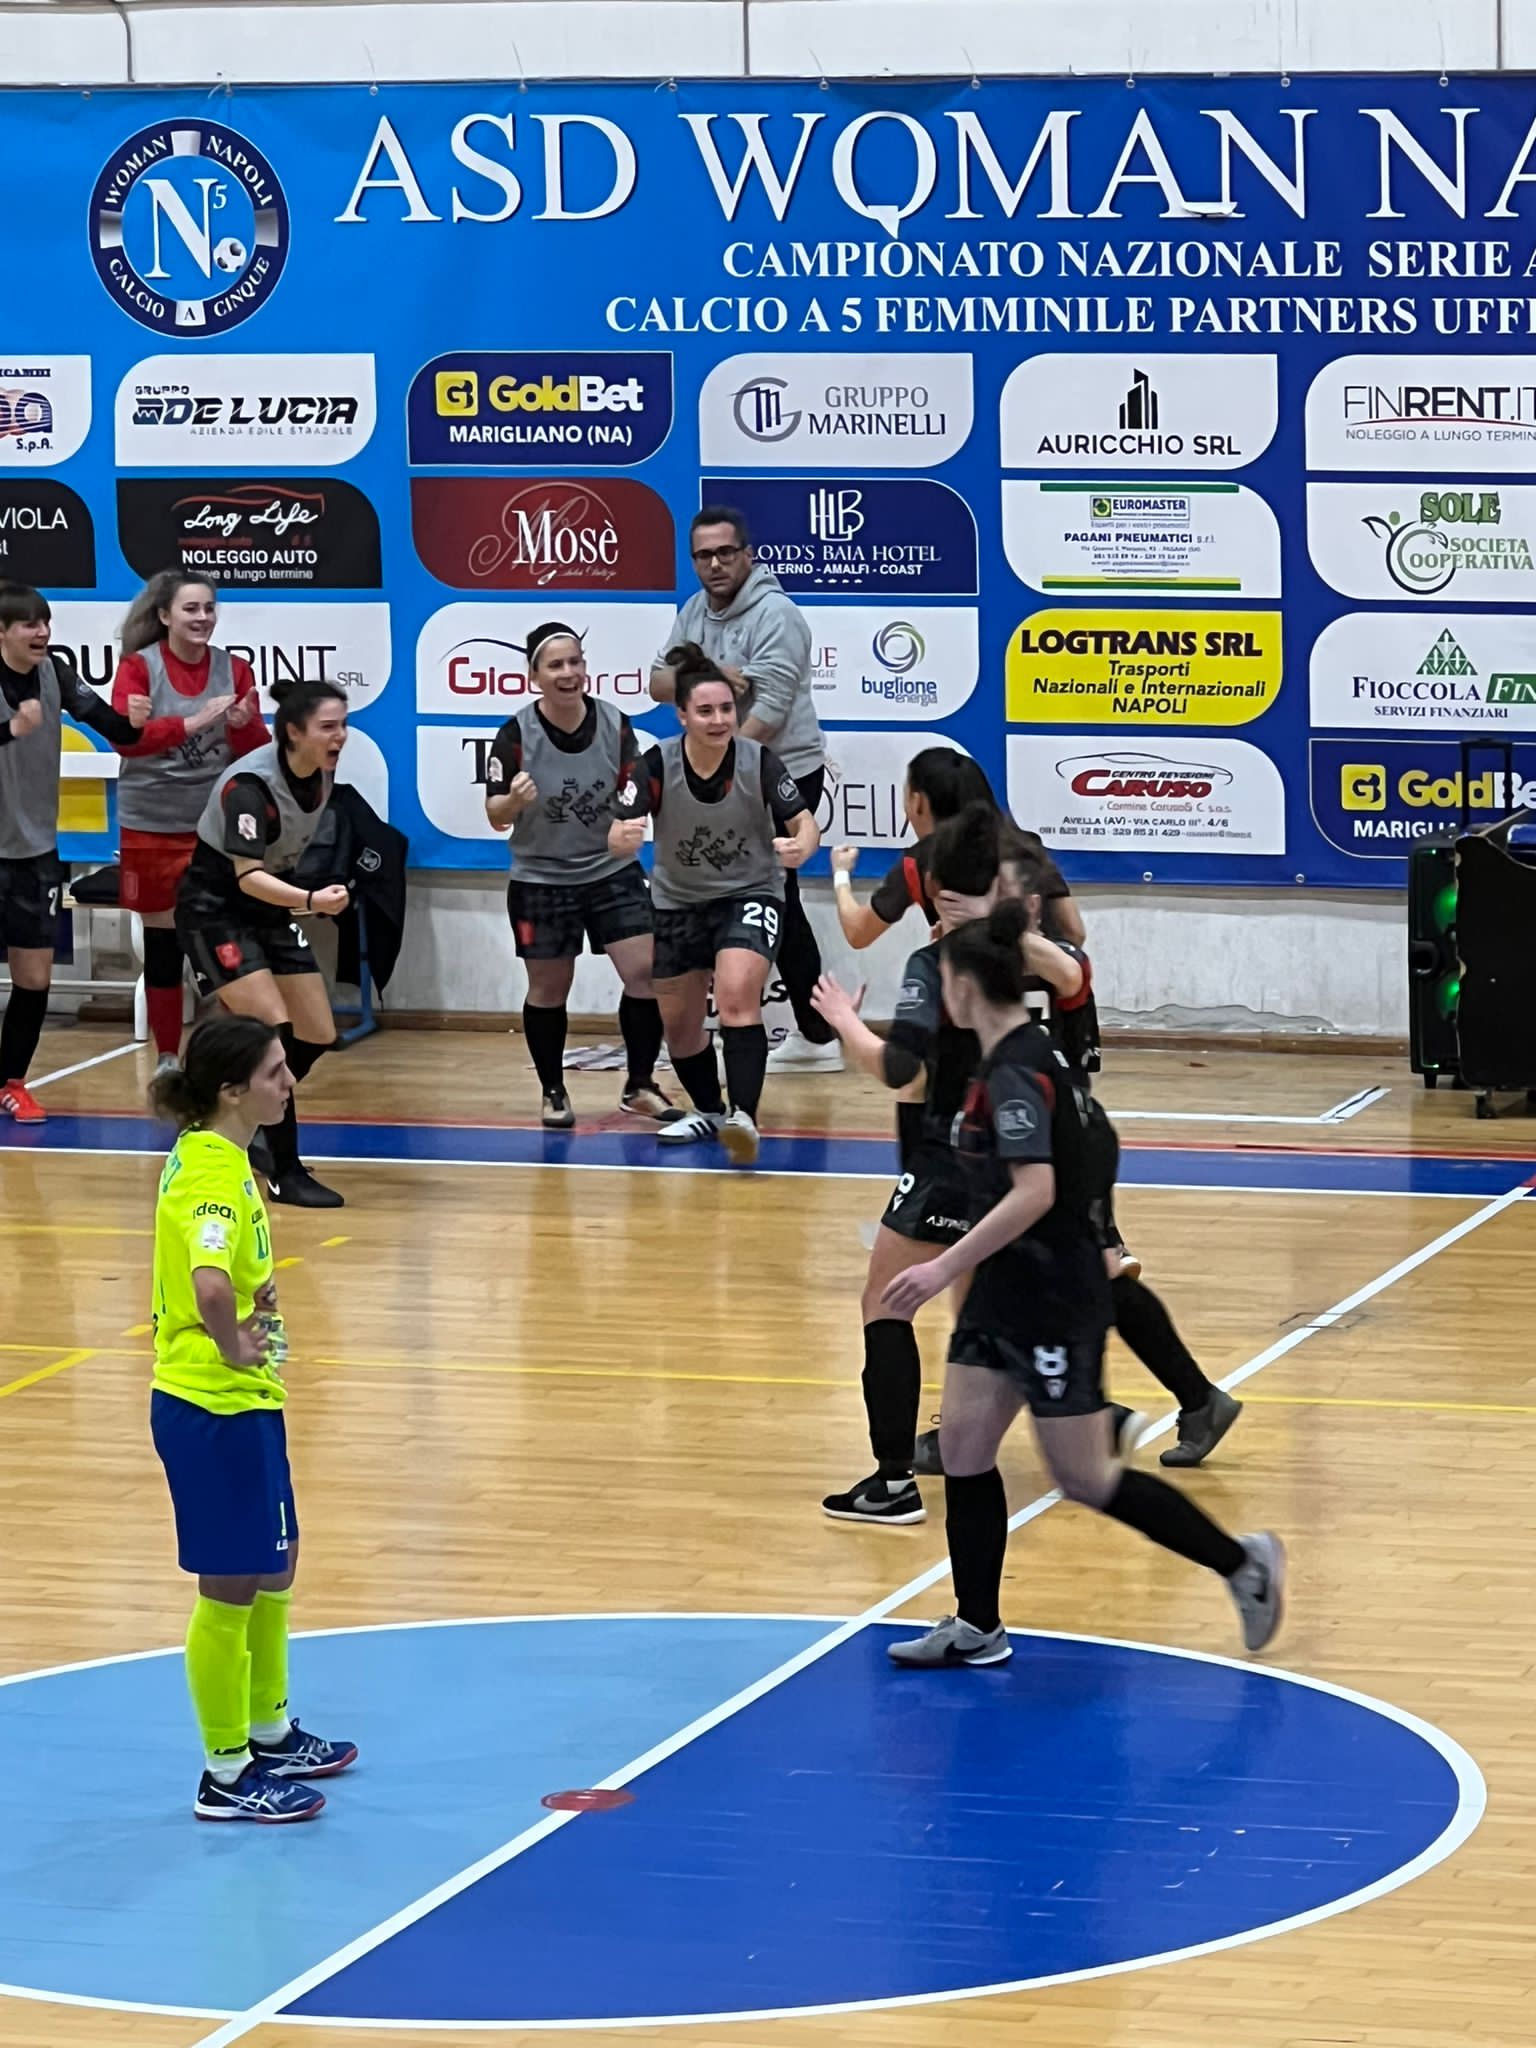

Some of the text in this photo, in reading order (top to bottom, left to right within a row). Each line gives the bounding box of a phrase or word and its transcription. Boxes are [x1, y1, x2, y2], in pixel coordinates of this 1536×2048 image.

[105, 135, 168, 205] WOMAN
[206, 135, 273, 206] NAPOLI
[334, 113, 637, 224] ASD
[678, 108, 1319, 228] WOMAN
[723, 242, 1044, 278] CAMPIONATO
[1057, 241, 1342, 277] NAZIONALE
[1368, 241, 1512, 278] SERIE
[109, 258, 165, 318] CALCIO
[213, 256, 270, 317] CINQUE
[605, 297, 789, 333] CALCIO
[800, 298, 832, 333] A
[841, 297, 863, 333] 5
[877, 298, 1154, 333] FEMMINILE
[1169, 297, 1417, 334] PARTNERS
[135, 386, 190, 395] GRUPPO
[489, 376, 643, 411] GoldBet
[825, 386, 929, 408] GRUPPO
[229, 397, 358, 425] LUCIA
[807, 413, 946, 435] MARINELLI
[1346, 429, 1417, 440] NOLEGGIO
[1420, 430, 1430, 440] A
[1434, 430, 1482, 441] LUNGO
[450, 425, 632, 447] MARIGLIANO (NA)
[1037, 434, 1241, 455] AURICCHIO SRL
[1113, 499, 1187, 510] EUROMASTER
[1420, 491, 1501, 525] SOLE
[184, 500, 319, 536] Long Life
[511, 510, 618, 564] Mosè
[1064, 532, 1112, 543] PAGANI
[1115, 532, 1193, 544] PNEUMATICI
[1450, 538, 1529, 553] SOCIETA
[182, 550, 318, 564] NOLEGGIO AUTO
[823, 545, 865, 561] BAIA
[872, 545, 942, 562] HOTEL
[823, 564, 869, 575] AMALFI
[880, 564, 923, 575] COAST
[1021, 630, 1263, 656] LOGTRANS SRL
[337, 672, 370, 687] SRL
[1109, 660, 1190, 680] Trasporti
[861, 676, 937, 699] buglione
[1033, 678, 1266, 697] Nazionali e Internazionali
[1352, 676, 1481, 701] FIOCCOLA
[1112, 698, 1187, 714] NAPOLI
[1375, 706, 1508, 718] SERVIZI FINANZIARI
[1071, 769, 1212, 798] CARUSO
[1111, 770, 1155, 779] CENTRO
[1063, 816, 1101, 825] AVELLA
[1104, 816, 1126, 826] (AV)
[1152, 818, 1186, 827] CARLO
